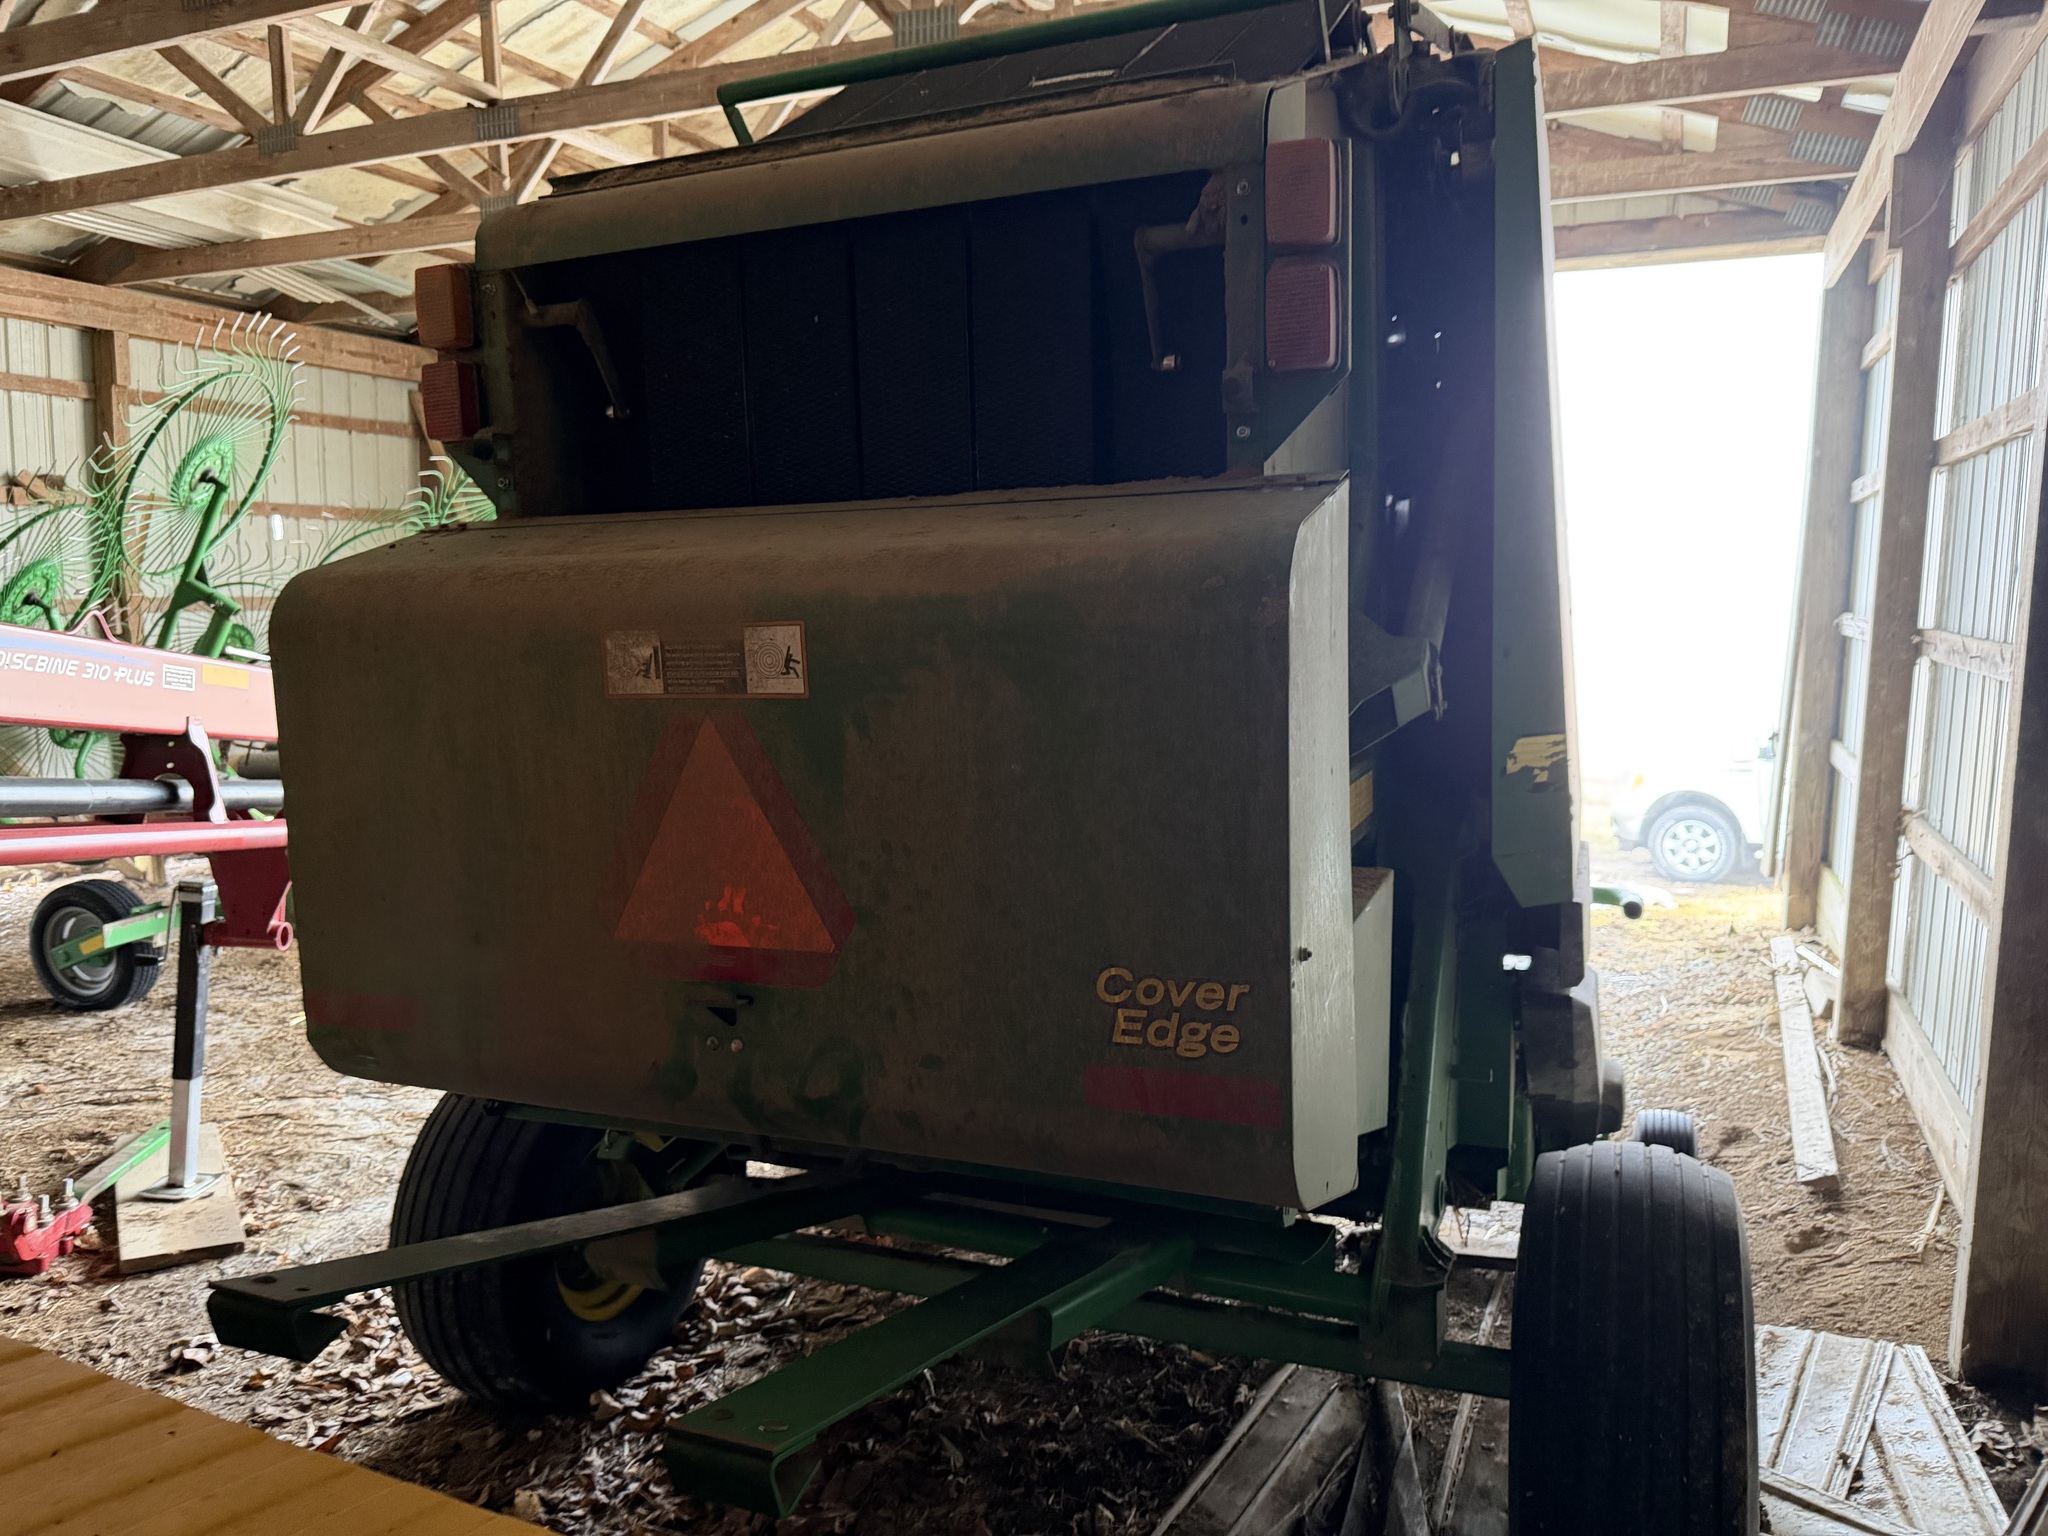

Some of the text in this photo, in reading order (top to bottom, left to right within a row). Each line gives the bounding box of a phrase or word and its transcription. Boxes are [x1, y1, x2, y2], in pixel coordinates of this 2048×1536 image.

[81, 662, 111, 681] 310
[114, 666, 156, 687] PLUS
[1096, 967, 1250, 1012] Cover
[1112, 1008, 1241, 1058] Edge
